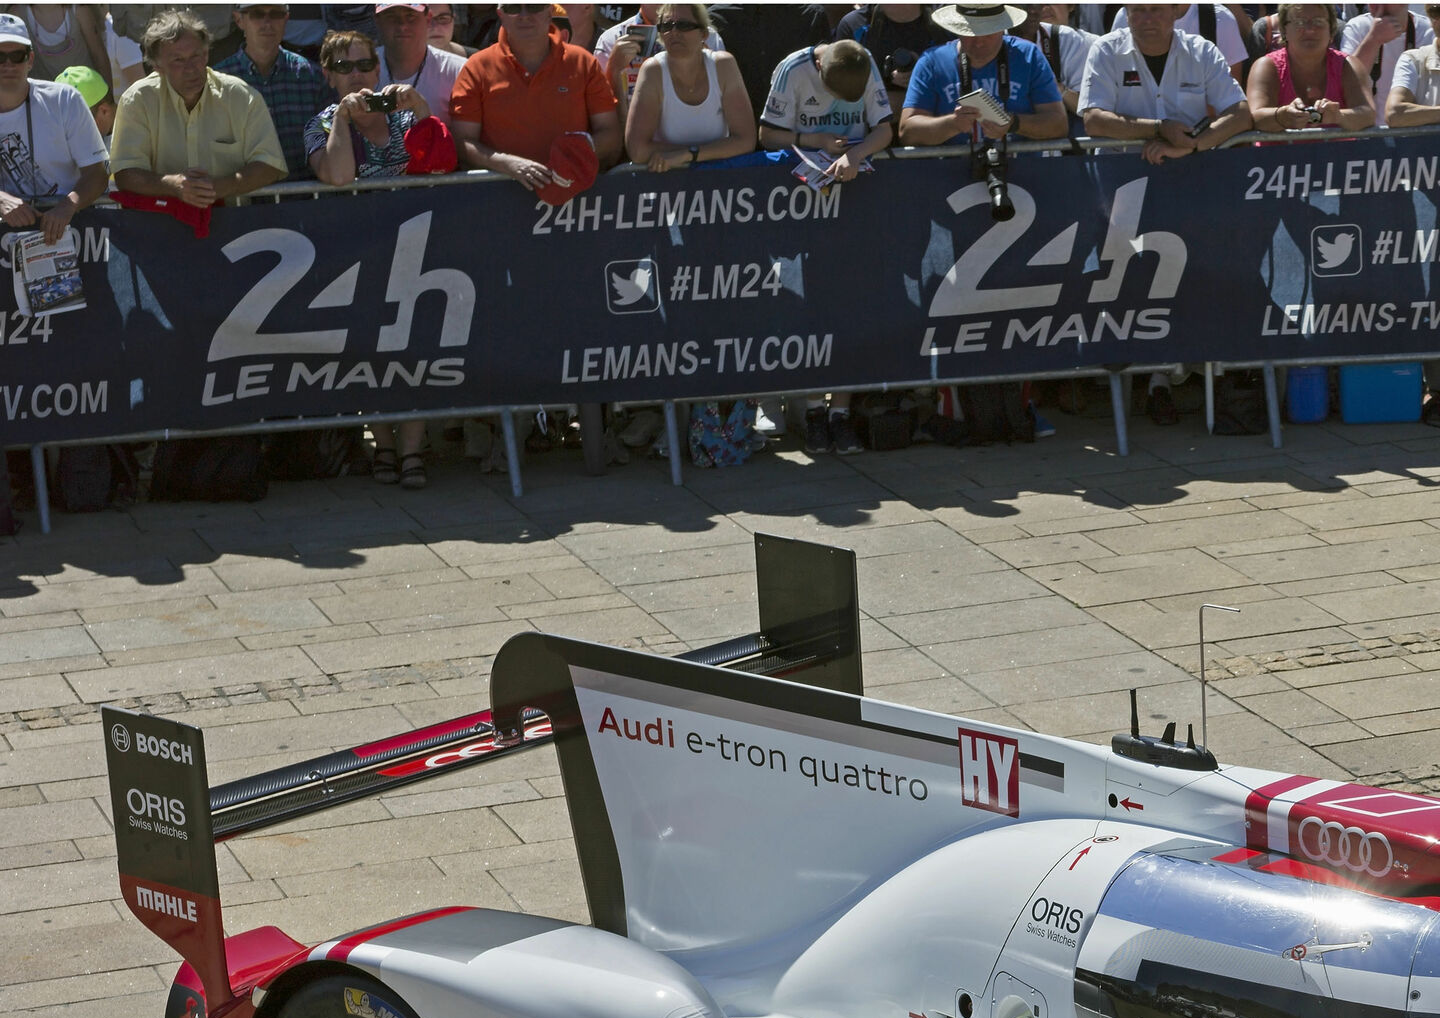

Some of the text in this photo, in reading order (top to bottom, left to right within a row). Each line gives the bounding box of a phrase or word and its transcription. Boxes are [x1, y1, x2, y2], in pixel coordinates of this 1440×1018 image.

[799, 111, 867, 127] SAMSUN
[532, 183, 842, 235] 24H-LEMANS.COM
[928, 176, 1188, 318] 24h
[207, 210, 477, 362] 24h
[670, 262, 783, 301] #LM24
[919, 308, 1172, 357] LE MANS
[561, 334, 834, 384] LEMANS-TV.COM
[0, 380, 108, 421] V.COM
[201, 357, 466, 406] LE MANS
[136, 733, 193, 766] BOSCH
[598, 707, 929, 802] Audi e-tron quattro
[961, 734, 1018, 812] HY
[127, 788, 187, 826] ORIS
[129, 815, 188, 841] Swiss Watches
[136, 886, 197, 922] MAHLE
[1030, 896, 1084, 935] ORIS
[1026, 921, 1077, 949] Swiss Watches
